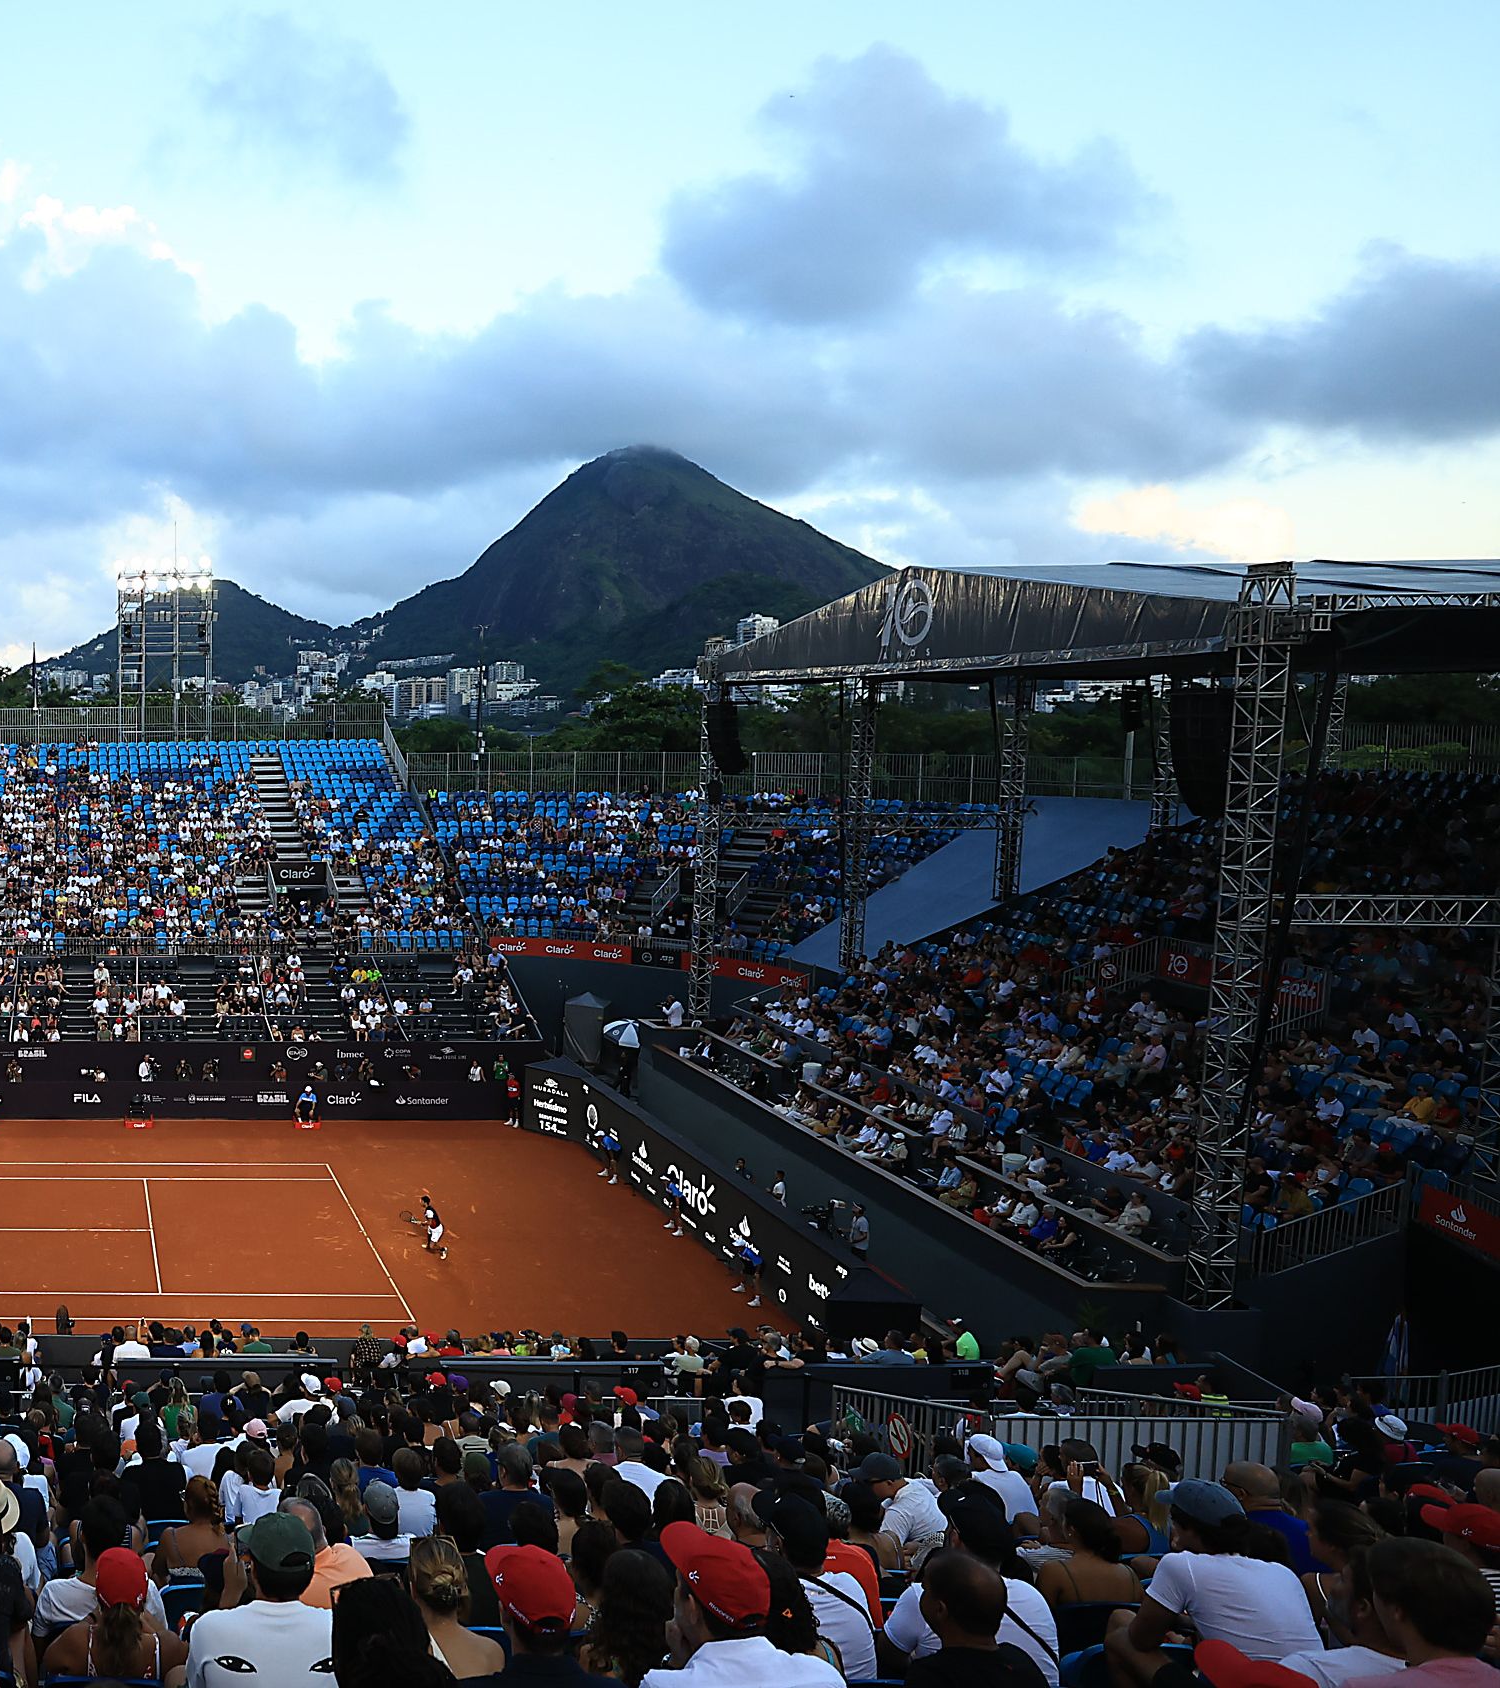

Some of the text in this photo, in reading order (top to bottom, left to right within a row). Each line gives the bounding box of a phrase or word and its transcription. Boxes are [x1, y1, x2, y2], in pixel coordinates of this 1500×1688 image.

[883, 648, 931, 661] ANOS
[280, 866, 315, 880] Claro
[498, 941, 527, 952] Claro
[545, 943, 575, 955] Claro
[593, 948, 622, 960] Claro
[738, 967, 764, 979] Claro
[18, 1050, 47, 1058] BRASIL
[336, 1048, 365, 1059] ibmec
[532, 1084, 569, 1098] MUBADALA
[73, 1093, 102, 1103] FILA
[257, 1094, 290, 1103] BRASIL
[327, 1091, 362, 1105] Claro
[407, 1096, 449, 1105] Santander
[1434, 1214, 1477, 1241] Santander
